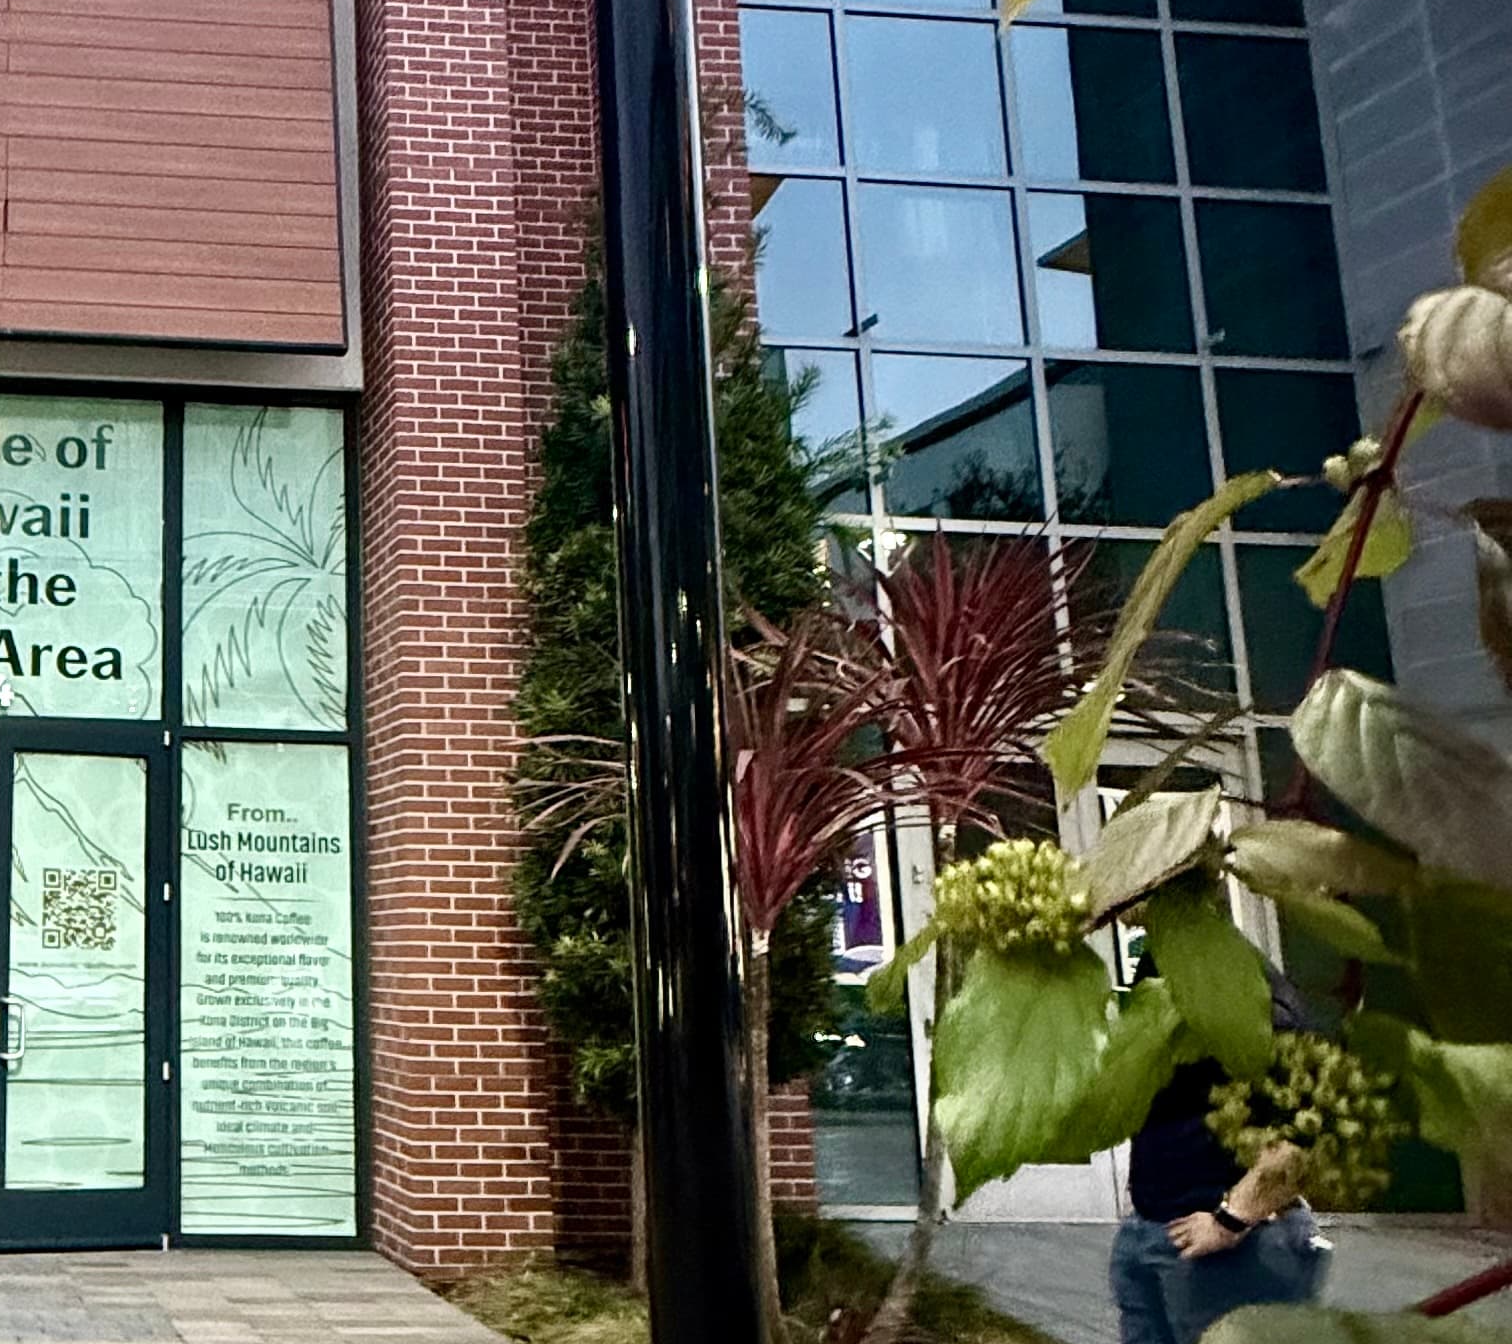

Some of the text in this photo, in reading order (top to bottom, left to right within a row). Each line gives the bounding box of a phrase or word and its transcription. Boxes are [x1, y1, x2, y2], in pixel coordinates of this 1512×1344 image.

[56, 423, 115, 471] of
[187, 829, 341, 854] Lush Mountains
[215, 860, 308, 884] of Hawaii
[231, 953, 296, 968] exceptional
